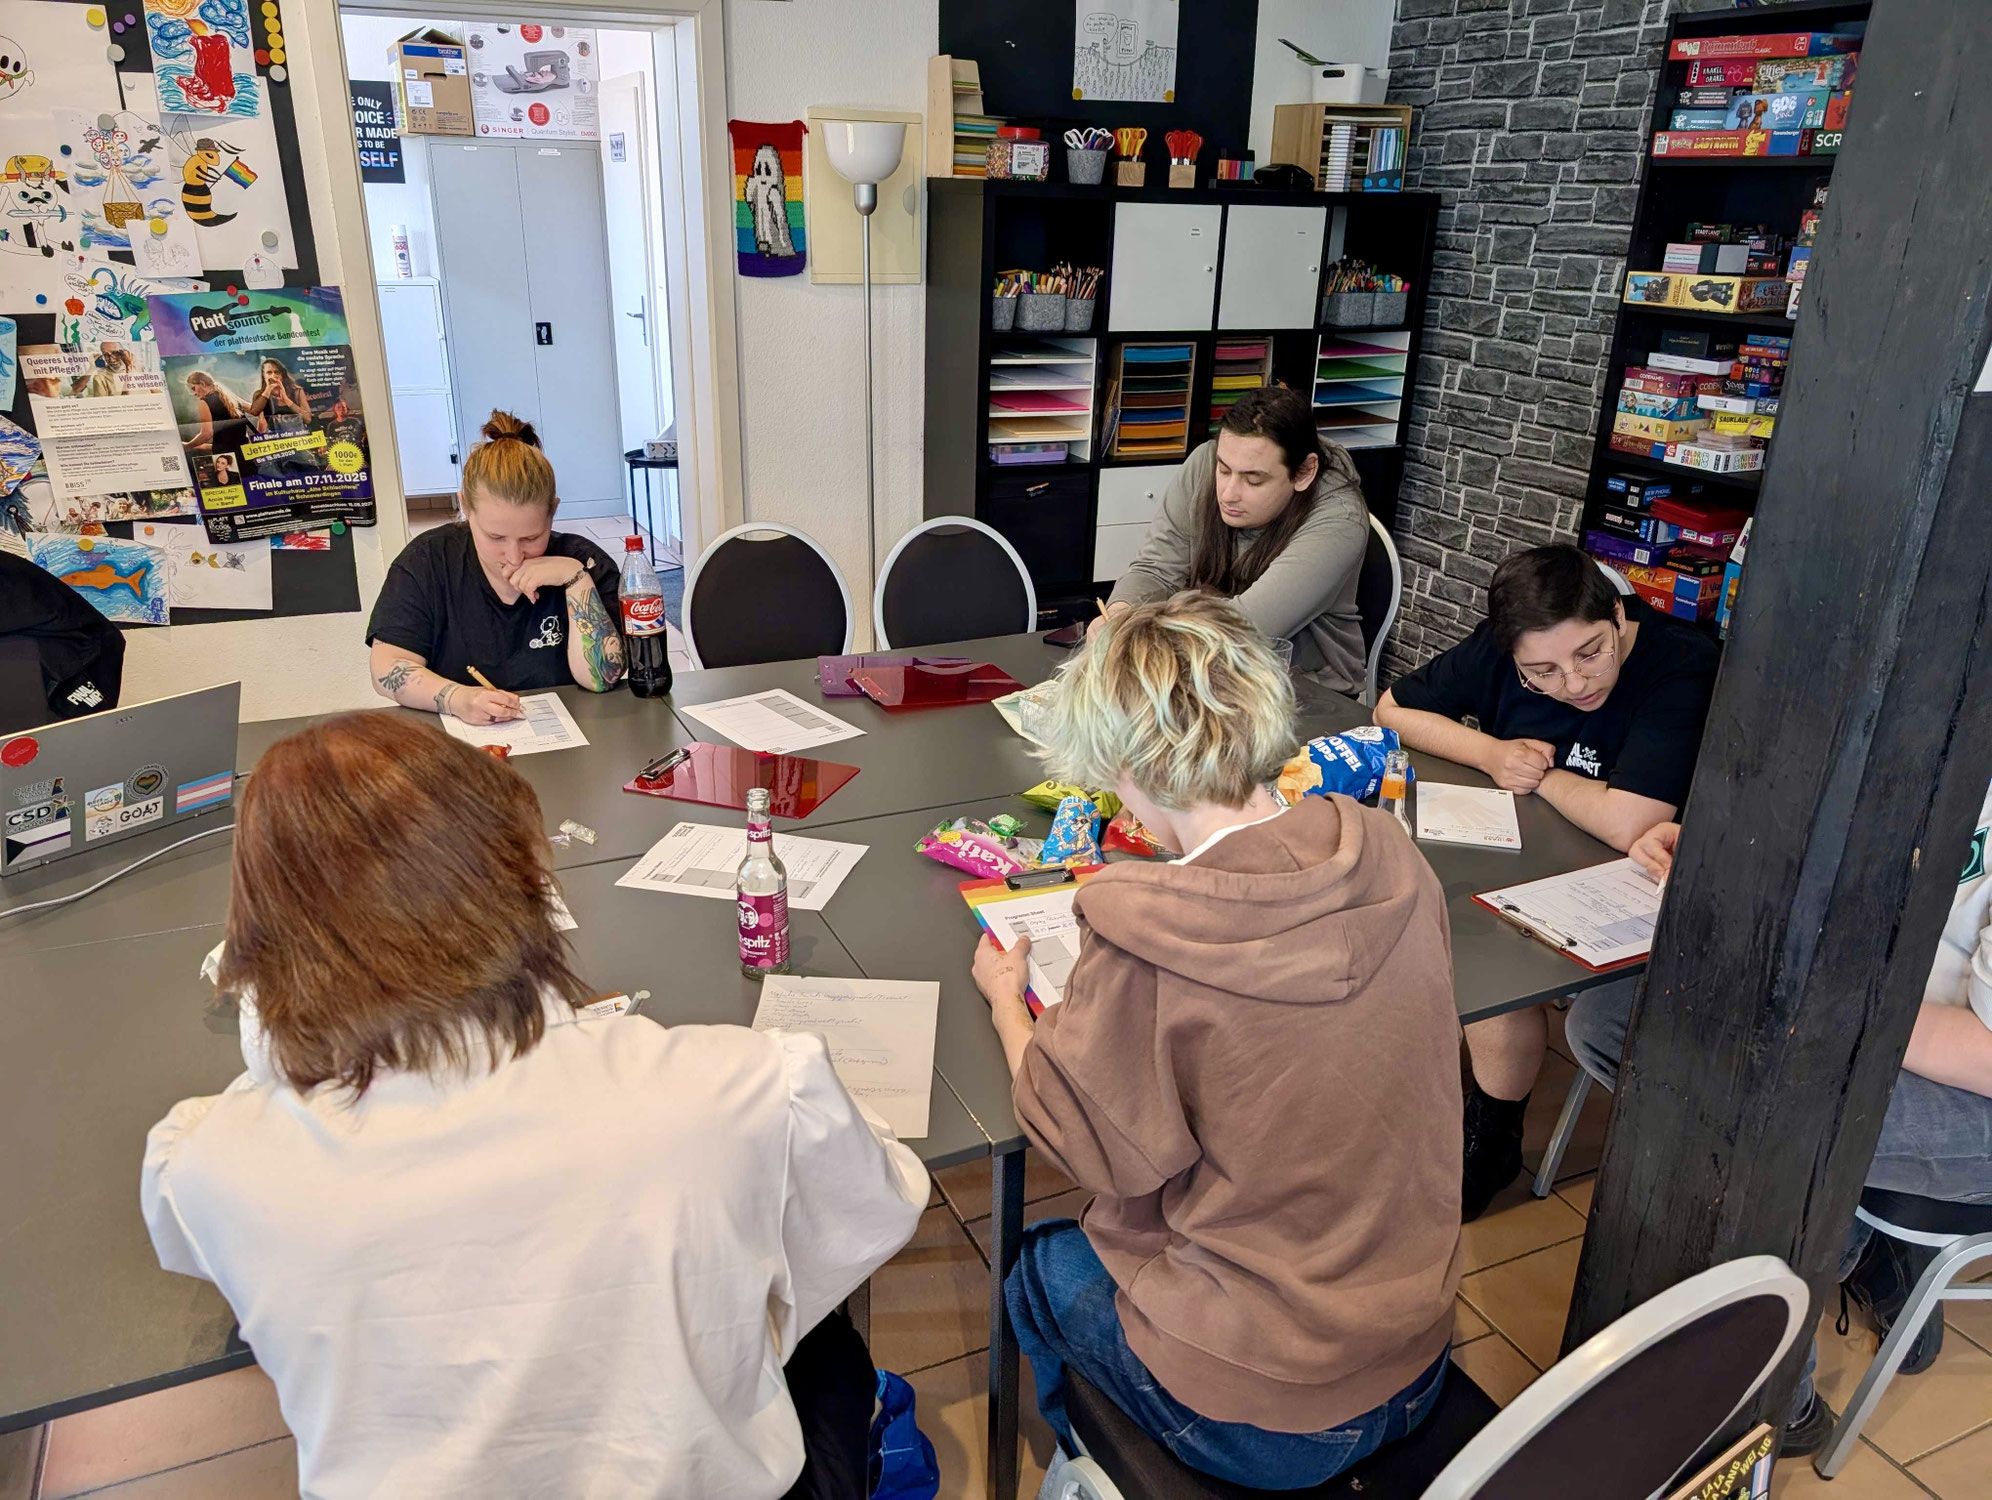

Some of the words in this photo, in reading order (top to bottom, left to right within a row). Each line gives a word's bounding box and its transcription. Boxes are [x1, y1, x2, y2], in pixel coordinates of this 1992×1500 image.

[438, 48, 459, 56] brother
[1703, 66, 1722, 74] KRAKEL
[1680, 91, 1692, 99] TOP
[357, 97, 382, 109] ONLY
[355, 111, 385, 124] OICE
[366, 127, 398, 139] MADE
[492, 126, 524, 134] SINGER
[531, 128, 558, 136] Quantum
[363, 140, 373, 148] TO
[1694, 137, 1739, 150] LABYRINTH
[1815, 133, 1842, 147] SCR
[360, 151, 398, 167] SELF
[191, 313, 227, 331] Platt
[227, 314, 270, 330] sounds
[214, 339, 225, 347] der
[228, 333, 276, 347] plattdeutsche
[277, 329, 320, 340] Bandcontest
[26, 357, 62, 366] Queeres
[63, 355, 89, 364] Leben
[33, 366, 48, 375] mit
[49, 364, 81, 375] Pflege?
[118, 374, 132, 383] Wir
[133, 373, 159, 381] wollen
[138, 380, 167, 388] wissen!
[1718, 415, 1750, 424] SAUKLAUE
[247, 444, 271, 456] Jetzt
[274, 435, 322, 450] bewerben!
[1683, 448, 1701, 458] COLOR
[1681, 455, 1701, 466] BRAIN
[249, 478, 283, 491] Finale
[285, 478, 302, 487] am
[305, 472, 368, 484] 07.11.2026
[1651, 596, 1665, 609] SPIEL
[82, 689, 104, 708] IMP
[1312, 740, 1338, 761] IPS
[1329, 736, 1362, 772] OFFEL
[9, 806, 51, 826] CSD
[120, 802, 160, 822] GOAT
[747, 826, 772, 841] -spritz
[949, 839, 1014, 876] Katje
[1757, 1435, 1772, 1458] LIG
[1739, 1450, 1757, 1476] WEI
[1721, 1460, 1741, 1495] LANG
[1702, 1484, 1713, 1498] LA
[1713, 1474, 1725, 1490] LA
